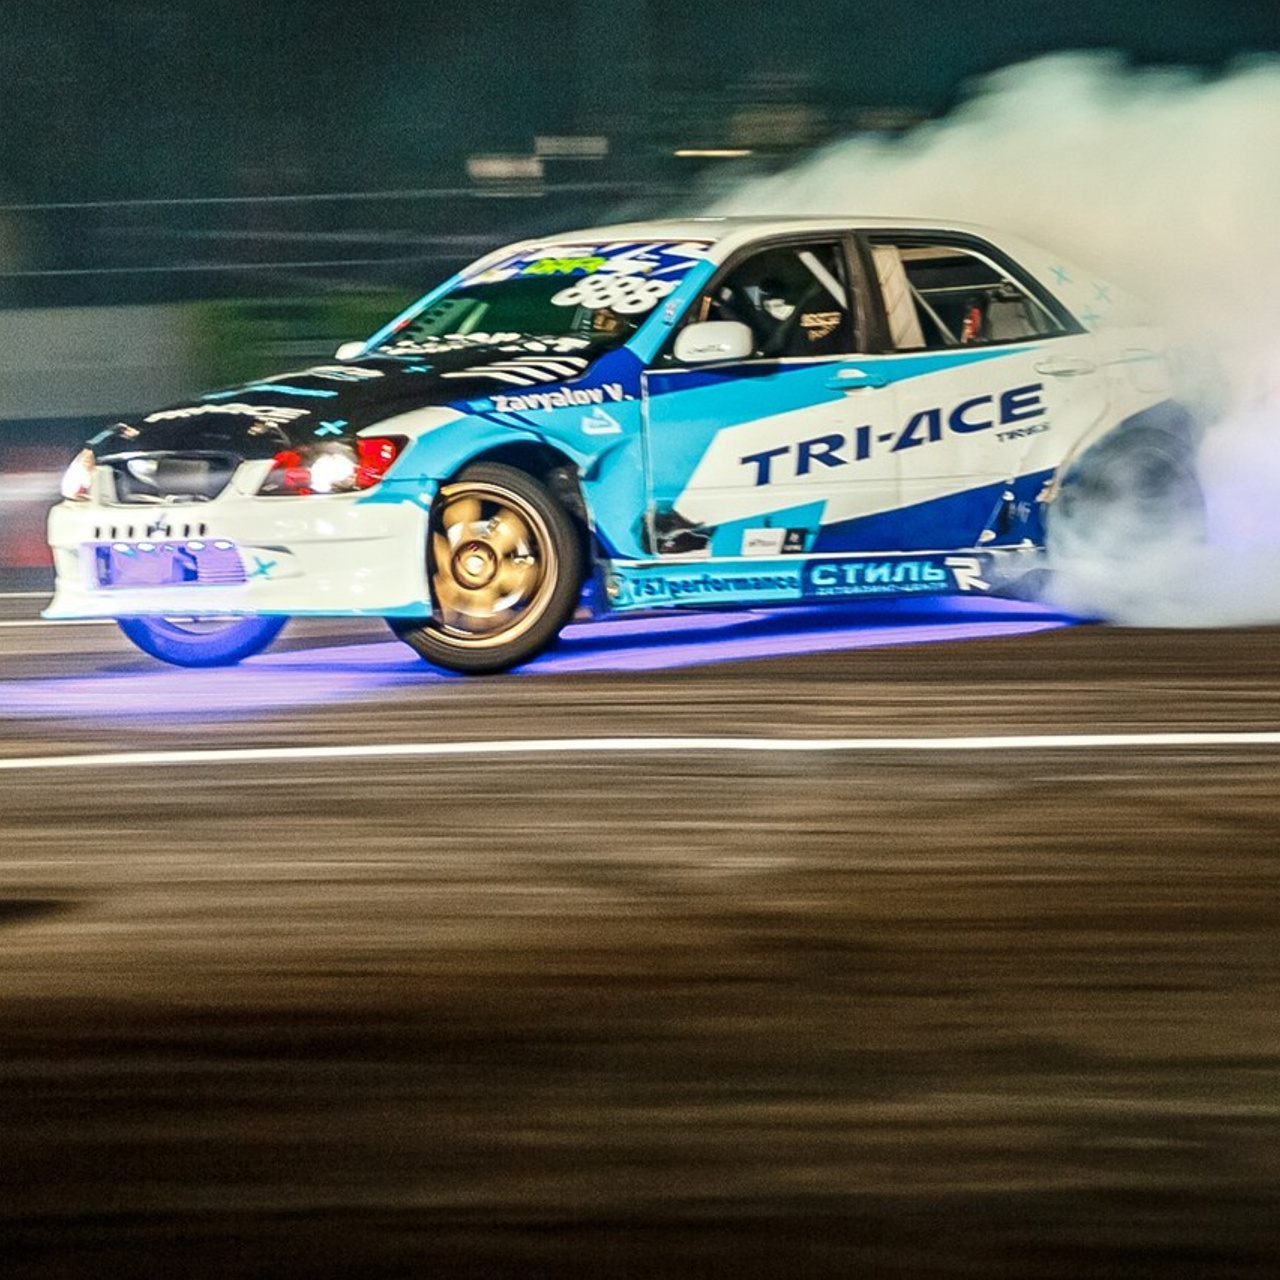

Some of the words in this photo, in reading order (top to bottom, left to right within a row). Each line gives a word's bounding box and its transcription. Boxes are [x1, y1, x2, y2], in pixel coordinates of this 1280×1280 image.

[490, 387, 604, 413] Zavyalov
[602, 383, 635, 402] V.
[739, 383, 1048, 487] TRI-ACE
[811, 561, 947, 585] СТИЛЬ
